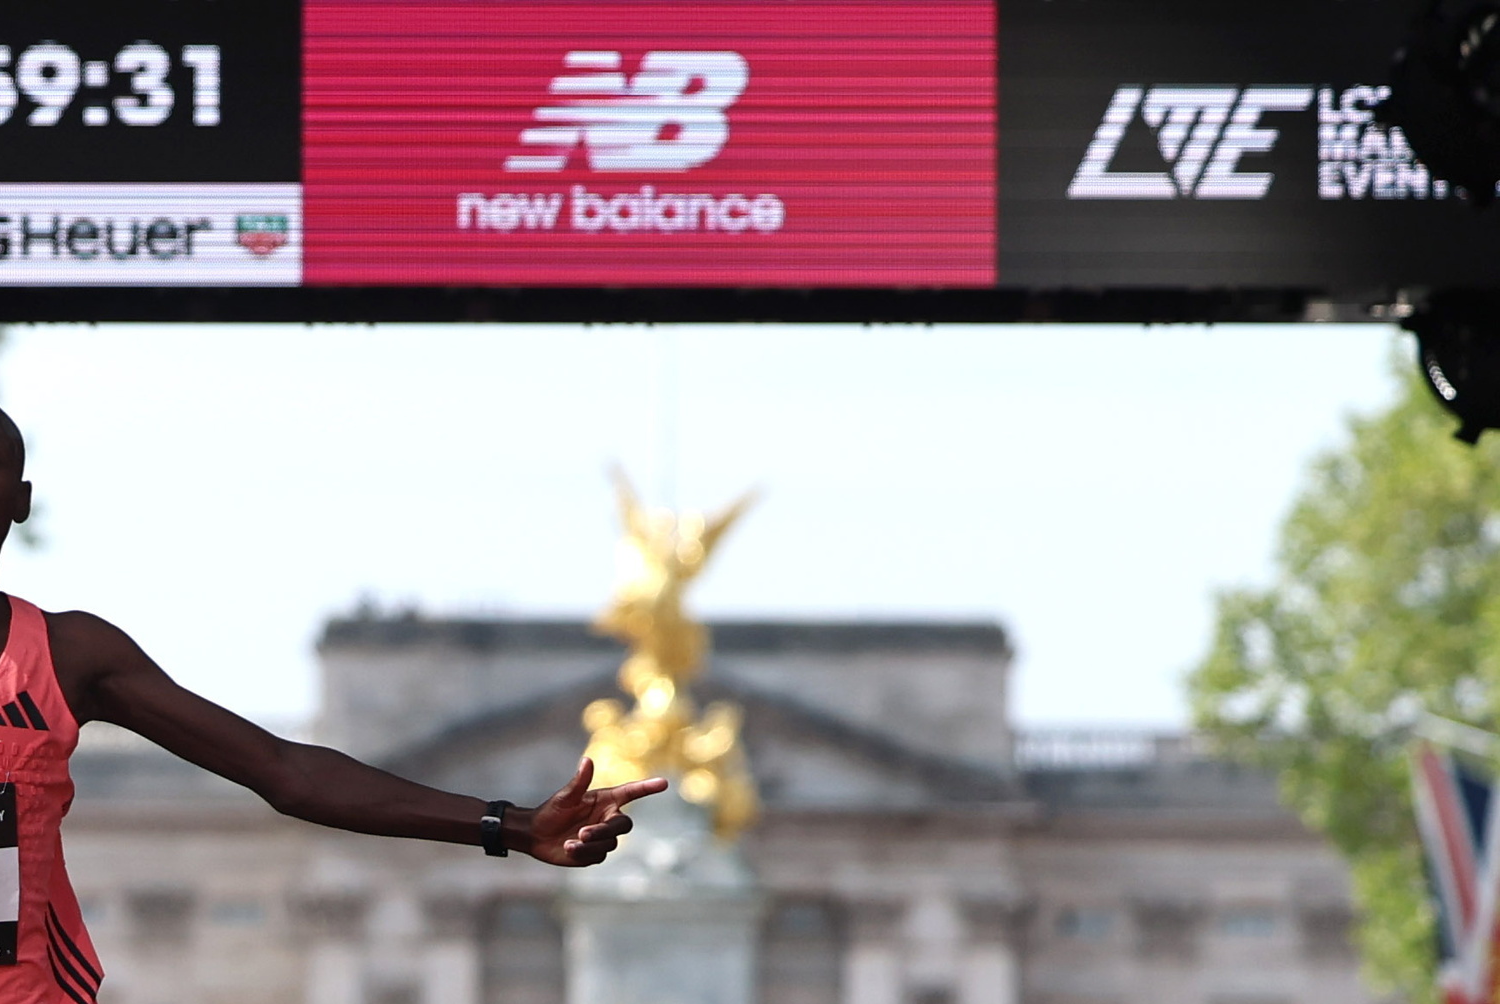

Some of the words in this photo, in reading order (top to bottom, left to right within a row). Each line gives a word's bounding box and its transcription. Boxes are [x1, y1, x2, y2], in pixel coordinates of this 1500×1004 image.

[1317, 161, 1466, 199] EVEN
[457, 193, 564, 230] new
[571, 185, 786, 234] balance
